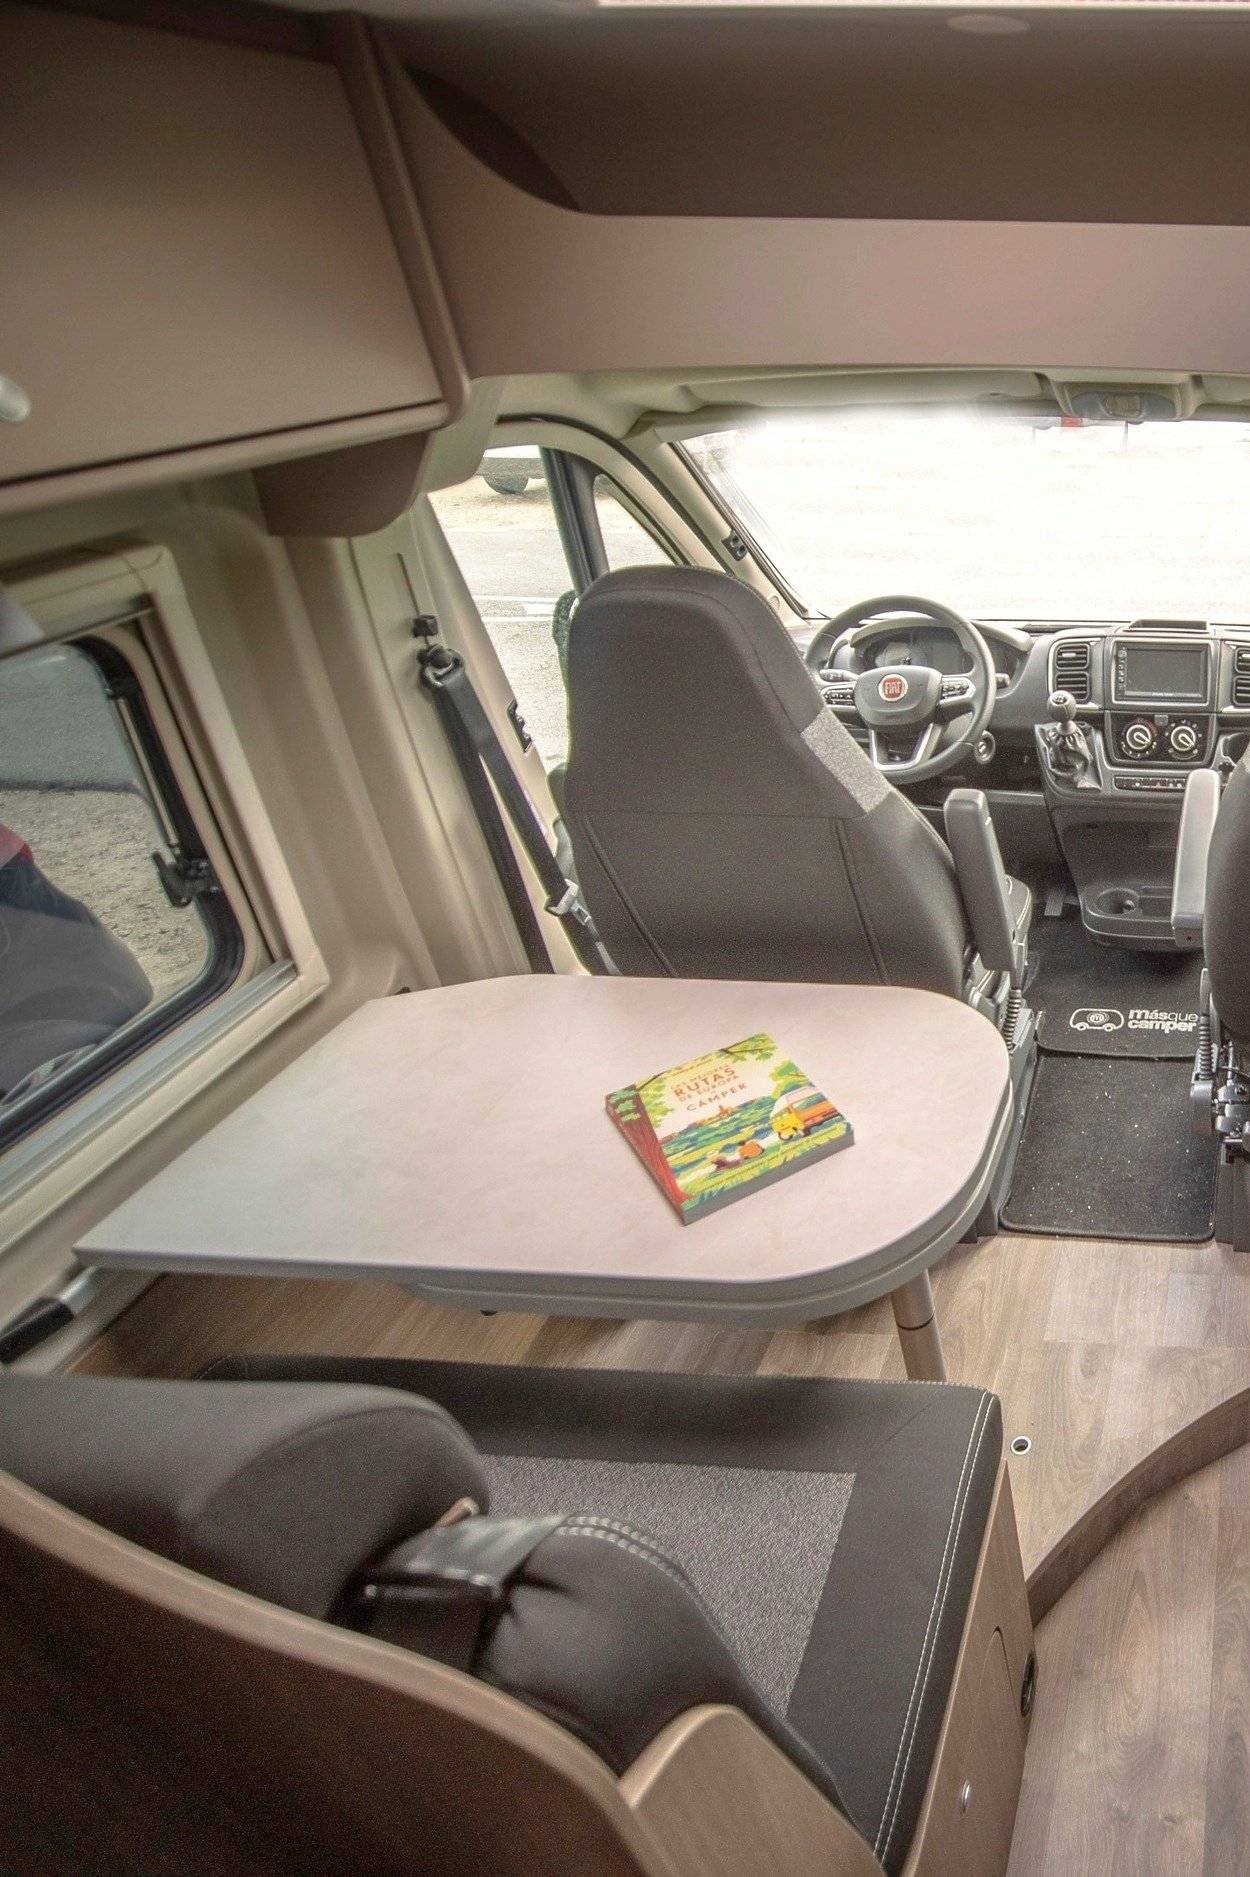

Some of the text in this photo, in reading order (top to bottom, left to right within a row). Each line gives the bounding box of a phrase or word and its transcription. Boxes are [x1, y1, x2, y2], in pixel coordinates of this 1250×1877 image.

[884, 681, 902, 695] FIAT
[1127, 1020, 1197, 1034] camper
[673, 1067, 735, 1097] RUTAS
[697, 1075, 739, 1095] EUROPA
[686, 1083, 747, 1111] CAMPER
